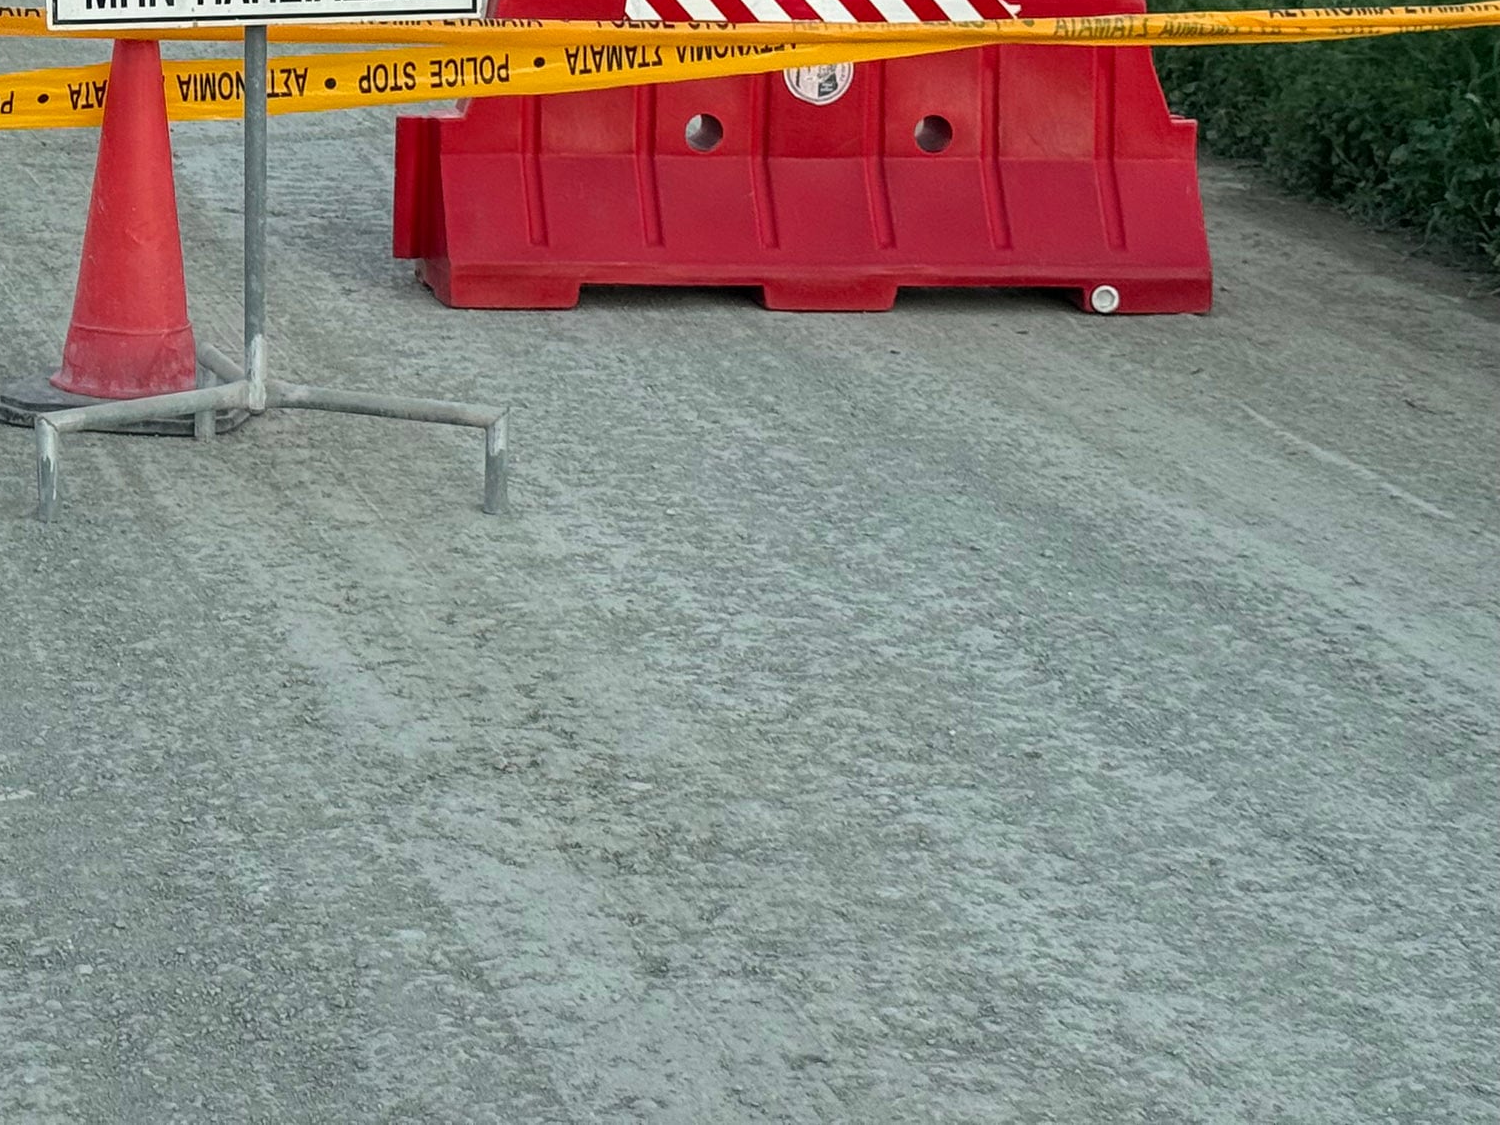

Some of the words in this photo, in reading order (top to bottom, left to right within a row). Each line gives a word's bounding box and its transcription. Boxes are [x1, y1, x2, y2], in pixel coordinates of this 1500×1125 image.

[430, 53, 510, 89] POLICE
[564, 44, 663, 75] ΣΤΑΜΑΤΑ
[176, 66, 309, 102] ΑΣΤΝΟΜΙΑ
[358, 60, 417, 94] STOP
[67, 79, 108, 110] ΑΤΑ
